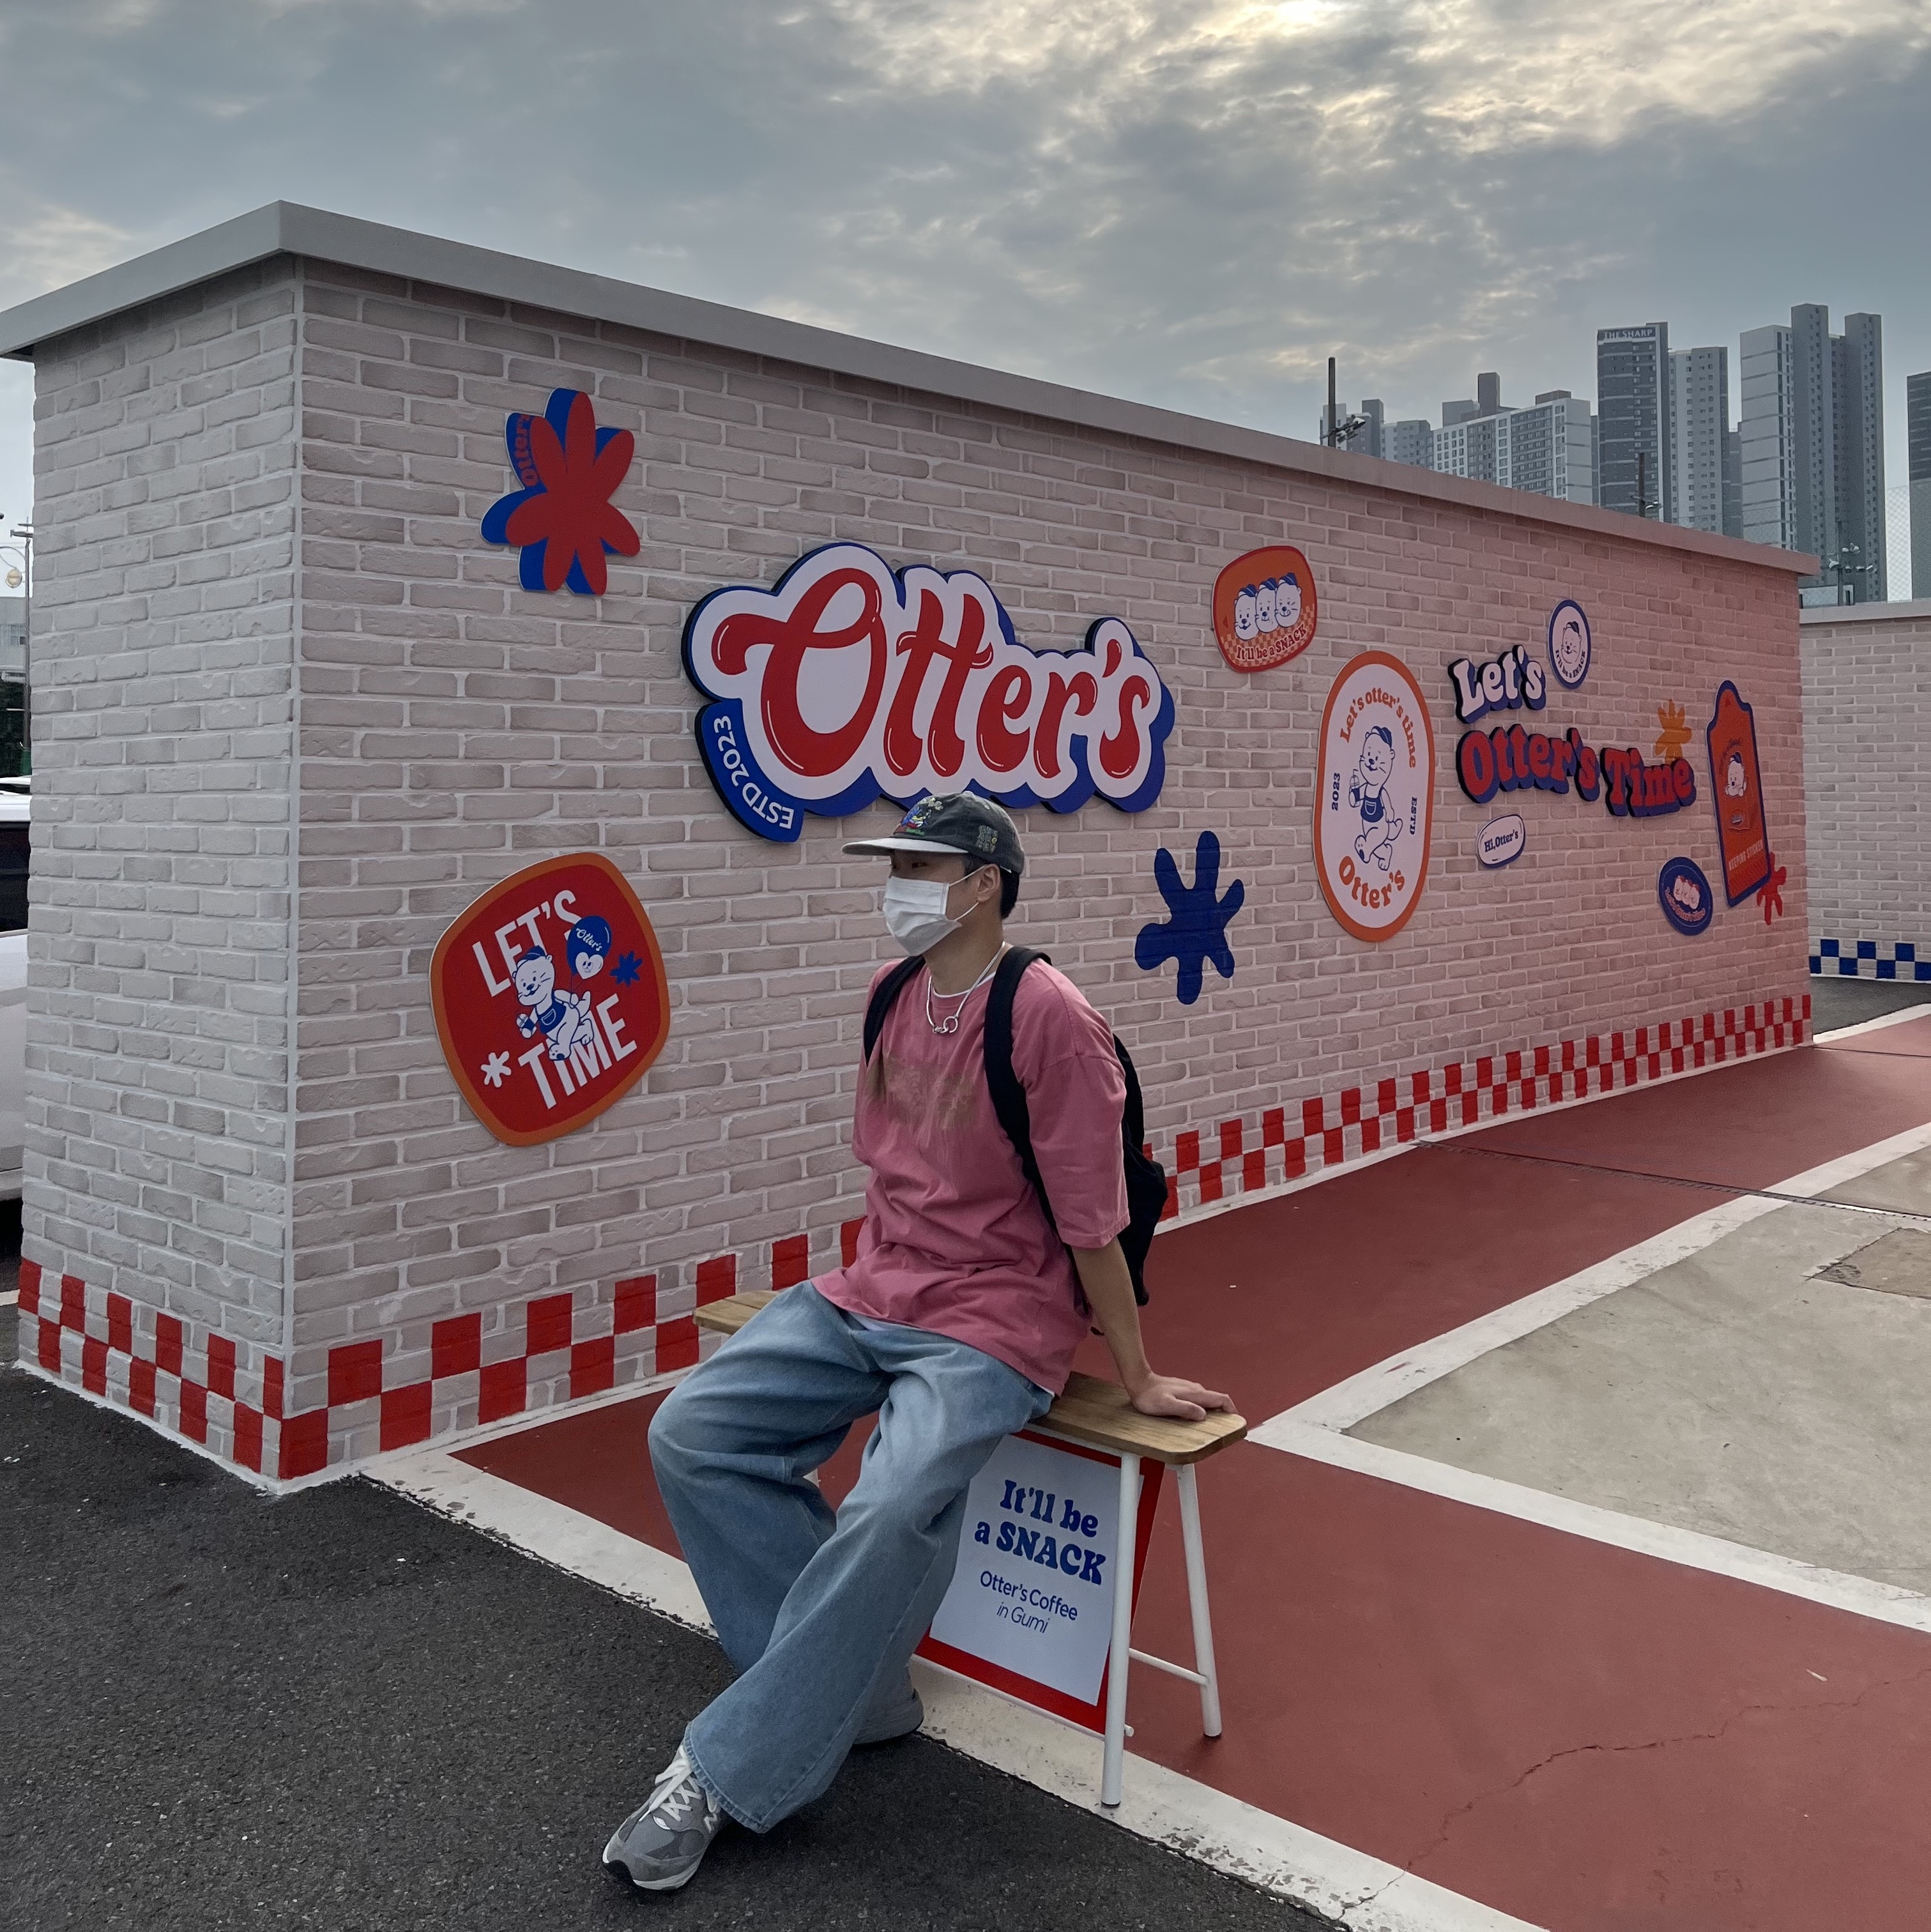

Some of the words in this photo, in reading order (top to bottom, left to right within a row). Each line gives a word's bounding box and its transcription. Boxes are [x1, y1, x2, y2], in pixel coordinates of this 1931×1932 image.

[1604, 331, 1621, 339] THE
[1622, 328, 1653, 338] SHARP
[1236, 646, 1255, 660] It'll
[1256, 646, 1268, 659] be
[1269, 647, 1275, 657] a
[1275, 623, 1307, 653] SNACK
[712, 567, 1150, 779] Otter's
[1453, 645, 1543, 717] Let's
[714, 715, 750, 787] 2023
[1339, 697, 1364, 743] Let's
[1365, 687, 1403, 719] otter's
[1402, 715, 1416, 768] time
[1331, 772, 1341, 812] 2023
[1461, 727, 1598, 796] Otter's
[1605, 749, 1692, 807] Time
[742, 782, 795, 830] ESTD
[1339, 856, 1405, 909] Otter's
[472, 890, 582, 998] LET'S
[576, 927, 602, 952] Otter's
[517, 993, 637, 1110] TIME
[1000, 1479, 1056, 1524] It'll
[1060, 1499, 1099, 1537] be
[974, 1521, 991, 1545] a
[996, 1521, 1106, 1585] SNACK
[980, 1571, 1028, 1602] Otter's
[1029, 1588, 1078, 1621] Coffee
[996, 1601, 1009, 1618] in
[1011, 1606, 1051, 1634] Gumi
